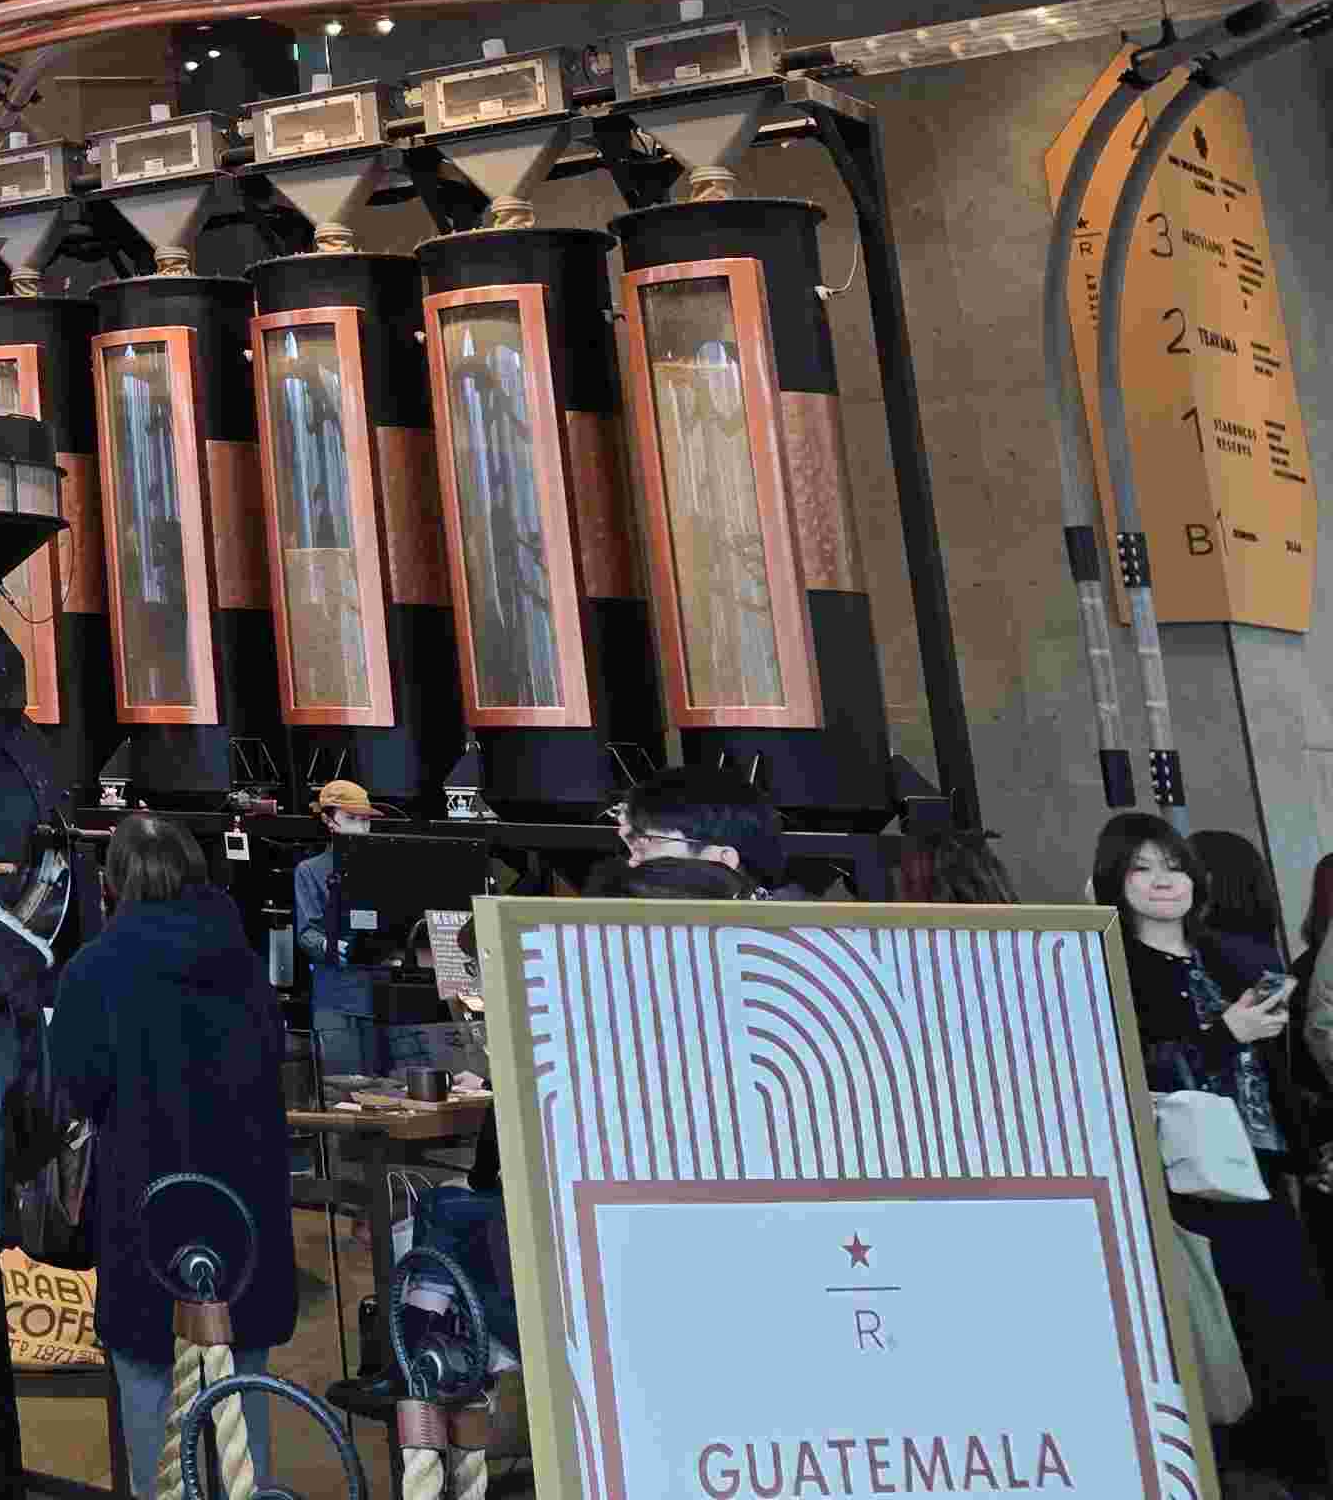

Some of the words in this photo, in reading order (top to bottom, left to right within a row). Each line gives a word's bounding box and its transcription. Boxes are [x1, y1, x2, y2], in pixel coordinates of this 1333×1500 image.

[1146, 212, 1174, 258] 3
[1161, 307, 1191, 355] 2
[1181, 405, 1205, 454] 1
[697, 1431, 1075, 1500] GUATEMALA
